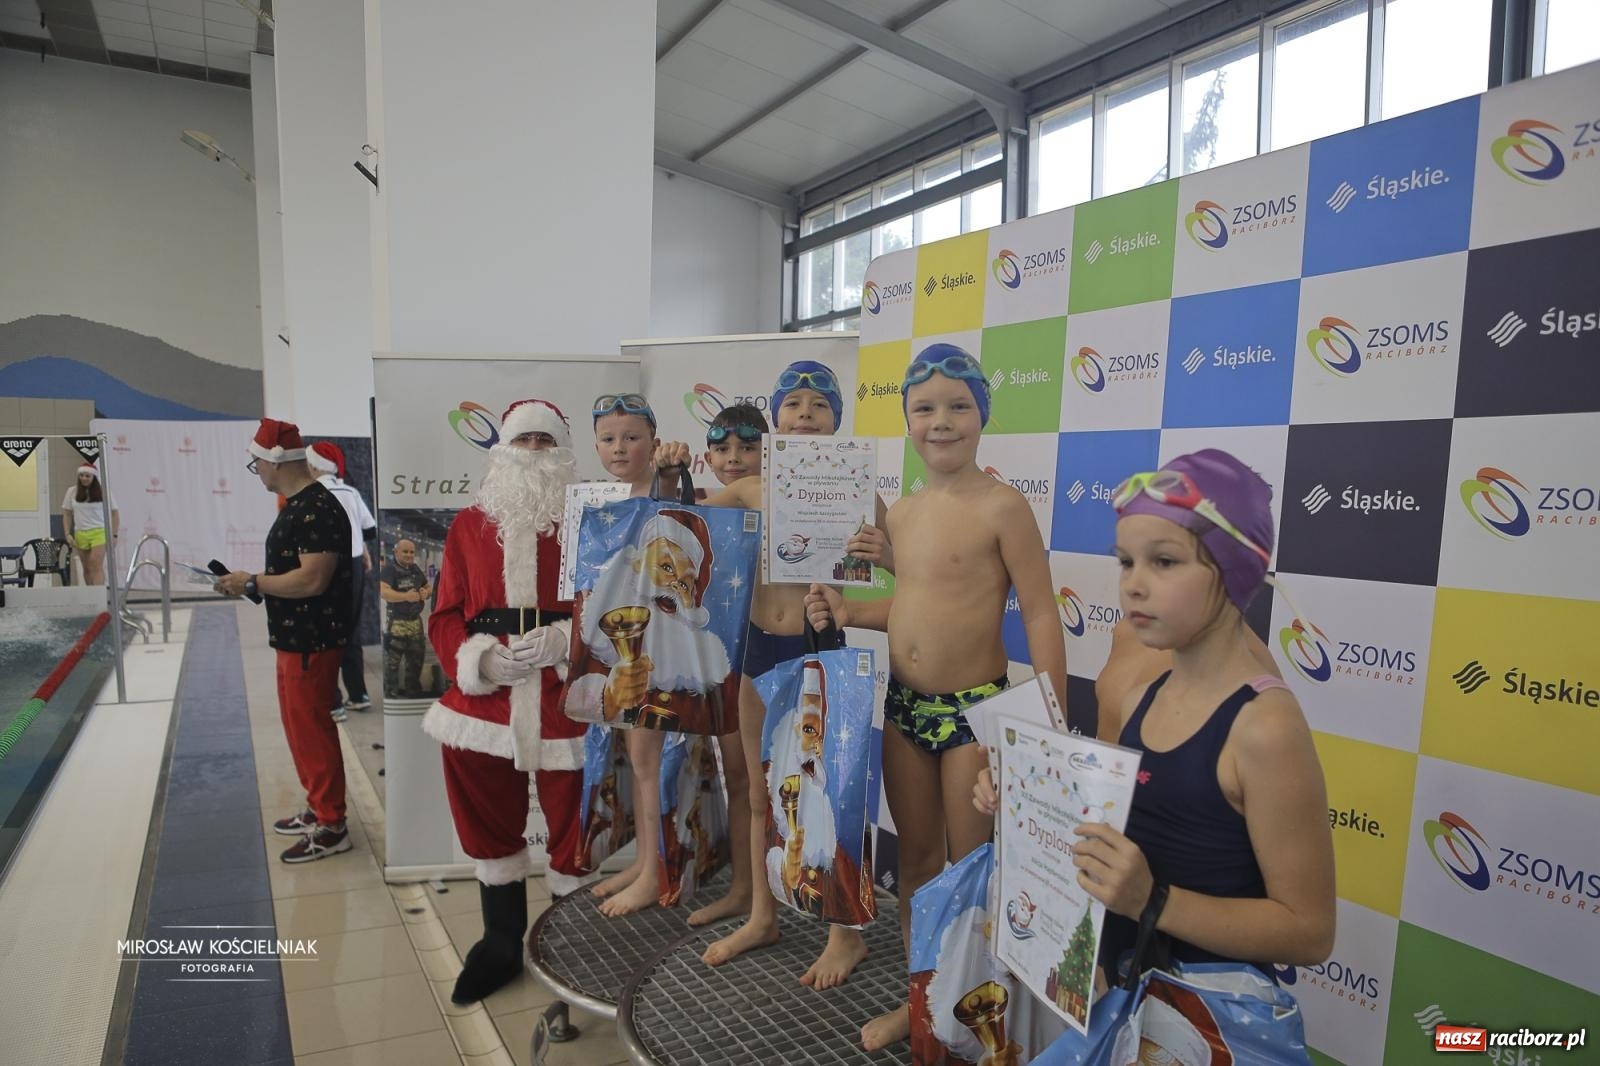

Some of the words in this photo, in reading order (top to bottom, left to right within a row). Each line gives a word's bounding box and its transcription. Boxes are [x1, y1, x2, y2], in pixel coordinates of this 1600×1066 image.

[1366, 166, 1450, 201] Śląskie.
[1232, 194, 1298, 225] ZSOMS
[1231, 216, 1297, 236] RACIBÓRZ
[1109, 231, 1161, 256] Śląskie.
[1023, 247, 1066, 271] ZSOMS
[882, 282, 913, 299] ZSOMS
[941, 272, 976, 291] Śląskie.
[1540, 306, 1600, 338] Śląs
[1366, 320, 1449, 349] ZSOMS
[1108, 352, 1160, 372] ZSOMS
[1212, 345, 1276, 370] Śląskie.
[1365, 344, 1448, 360] RACIBÓRZ
[1009, 367, 1052, 386] Śląskie.
[871, 382, 901, 398] Śląskie.
[3, 440, 33, 448] arena
[76, 440, 98, 448] aren
[391, 473, 471, 495] Straż
[876, 476, 900, 489] OMS
[797, 488, 847, 503] Dyplom
[1340, 486, 1421, 515] Śląskie.
[1537, 487, 1600, 511] ZSO
[1536, 514, 1600, 526] RACIB
[1088, 604, 1121, 625] ZSOM
[1336, 640, 1417, 674] ZSOMS
[1335, 664, 1416, 686] RACIBÓRZ
[1502, 667, 1600, 708] Śląskie
[1329, 808, 1385, 838] ąskie.
[1301, 972, 1378, 1012] RACIBÓRZ
